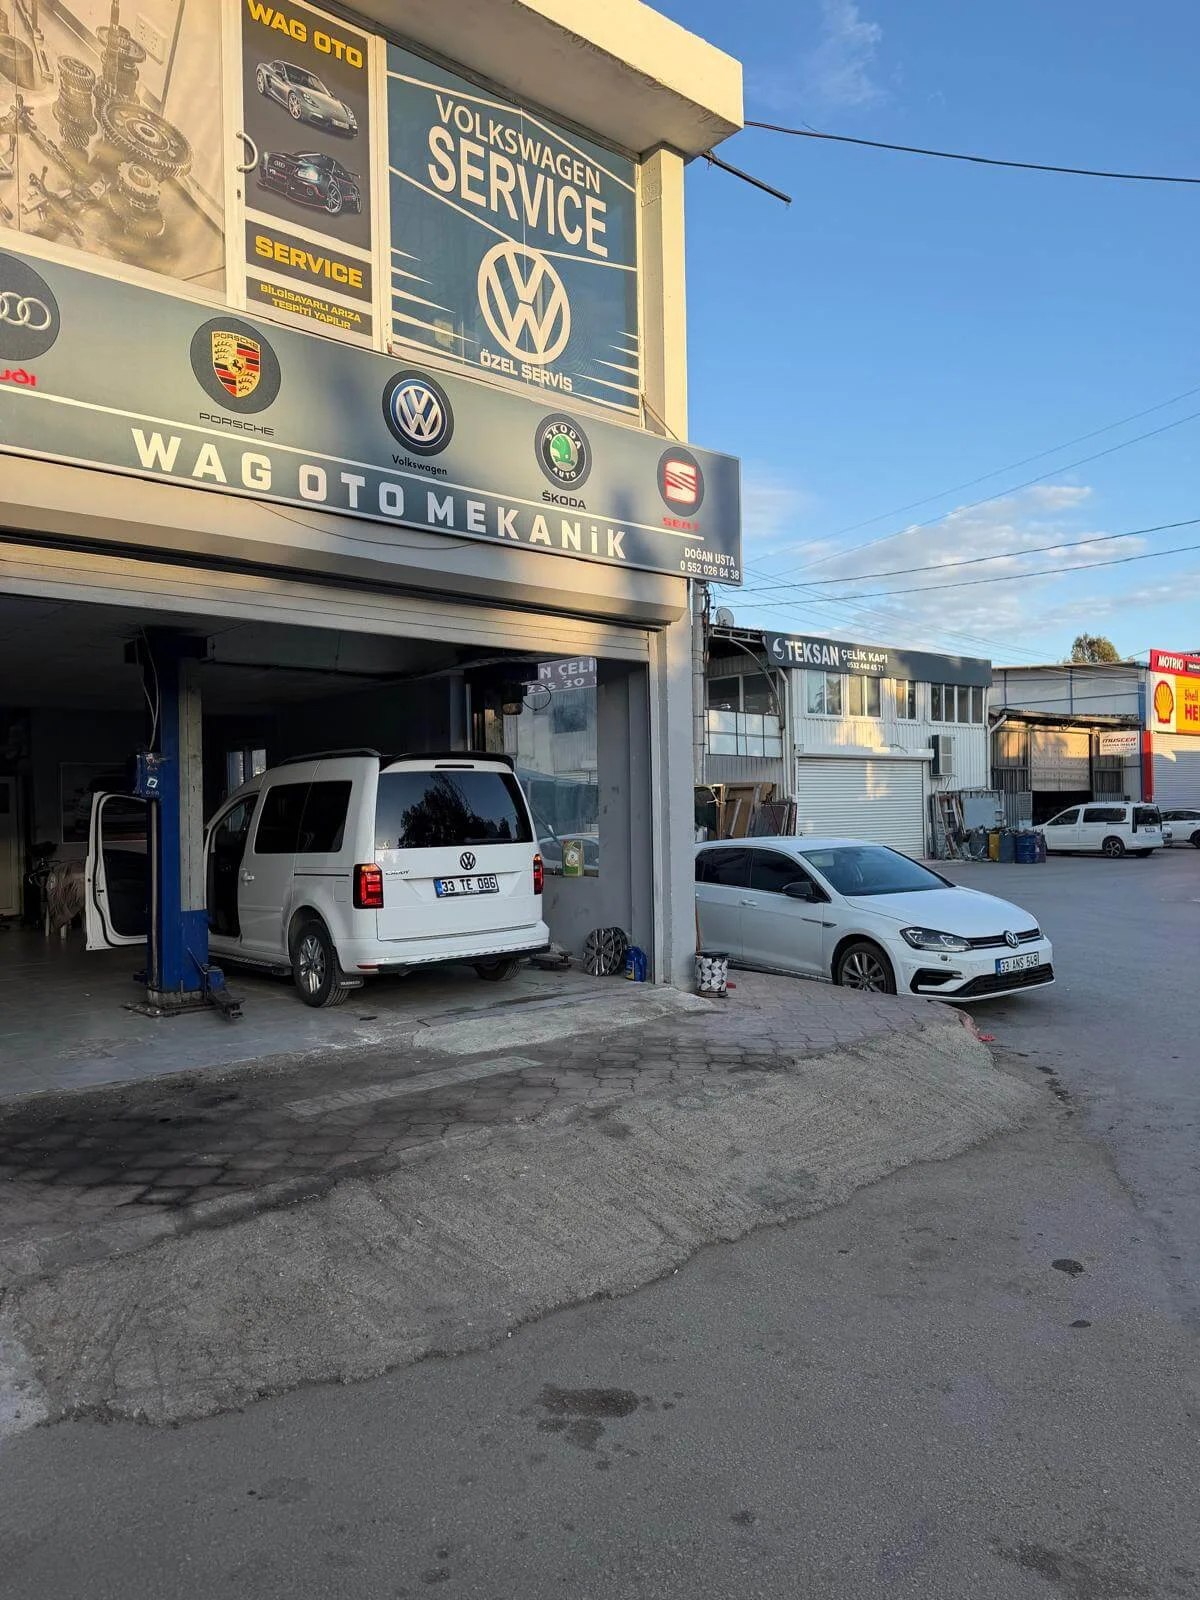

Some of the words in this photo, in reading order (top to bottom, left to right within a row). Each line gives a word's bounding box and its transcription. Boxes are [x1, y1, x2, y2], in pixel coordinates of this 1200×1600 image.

[247, 0, 307, 43] WAG
[314, 30, 363, 69] OTO
[435, 94, 600, 193] VOLKSWAGEN
[427, 125, 608, 258] SERVICE
[255, 235, 363, 289] SERVICE
[331, 306, 361, 323] ARIZA
[213, 333, 259, 350] PORSCHE
[480, 349, 519, 376] ÖZEL
[199, 412, 275, 436] PORSCHE
[131, 427, 272, 491] WAG
[299, 464, 404, 517] OTO
[392, 454, 448, 475] Volkswagen
[552, 467, 576, 479] AUTO
[542, 489, 587, 509] ŠKODA
[684, 547, 713, 563] DOĞAN
[715, 553, 735, 567] USTA
[680, 560, 686, 571] 0
[687, 561, 702, 573] 552
[703, 565, 718, 576] 026
[719, 567, 729, 578] 84
[730, 569, 740, 580] 38
[785, 640, 840, 666] TEKSAN
[841, 648, 867, 661] ÇELİK
[868, 653, 888, 664] KAPI
[1158, 655, 1184, 671] MOTRIO
[1185, 703, 1200, 721] HE
[442, 881, 455, 892] 33
[460, 878, 473, 891] TE
[477, 877, 496, 889] 086
[1001, 961, 1010, 972] 33
[1012, 957, 1024, 969] ANS
